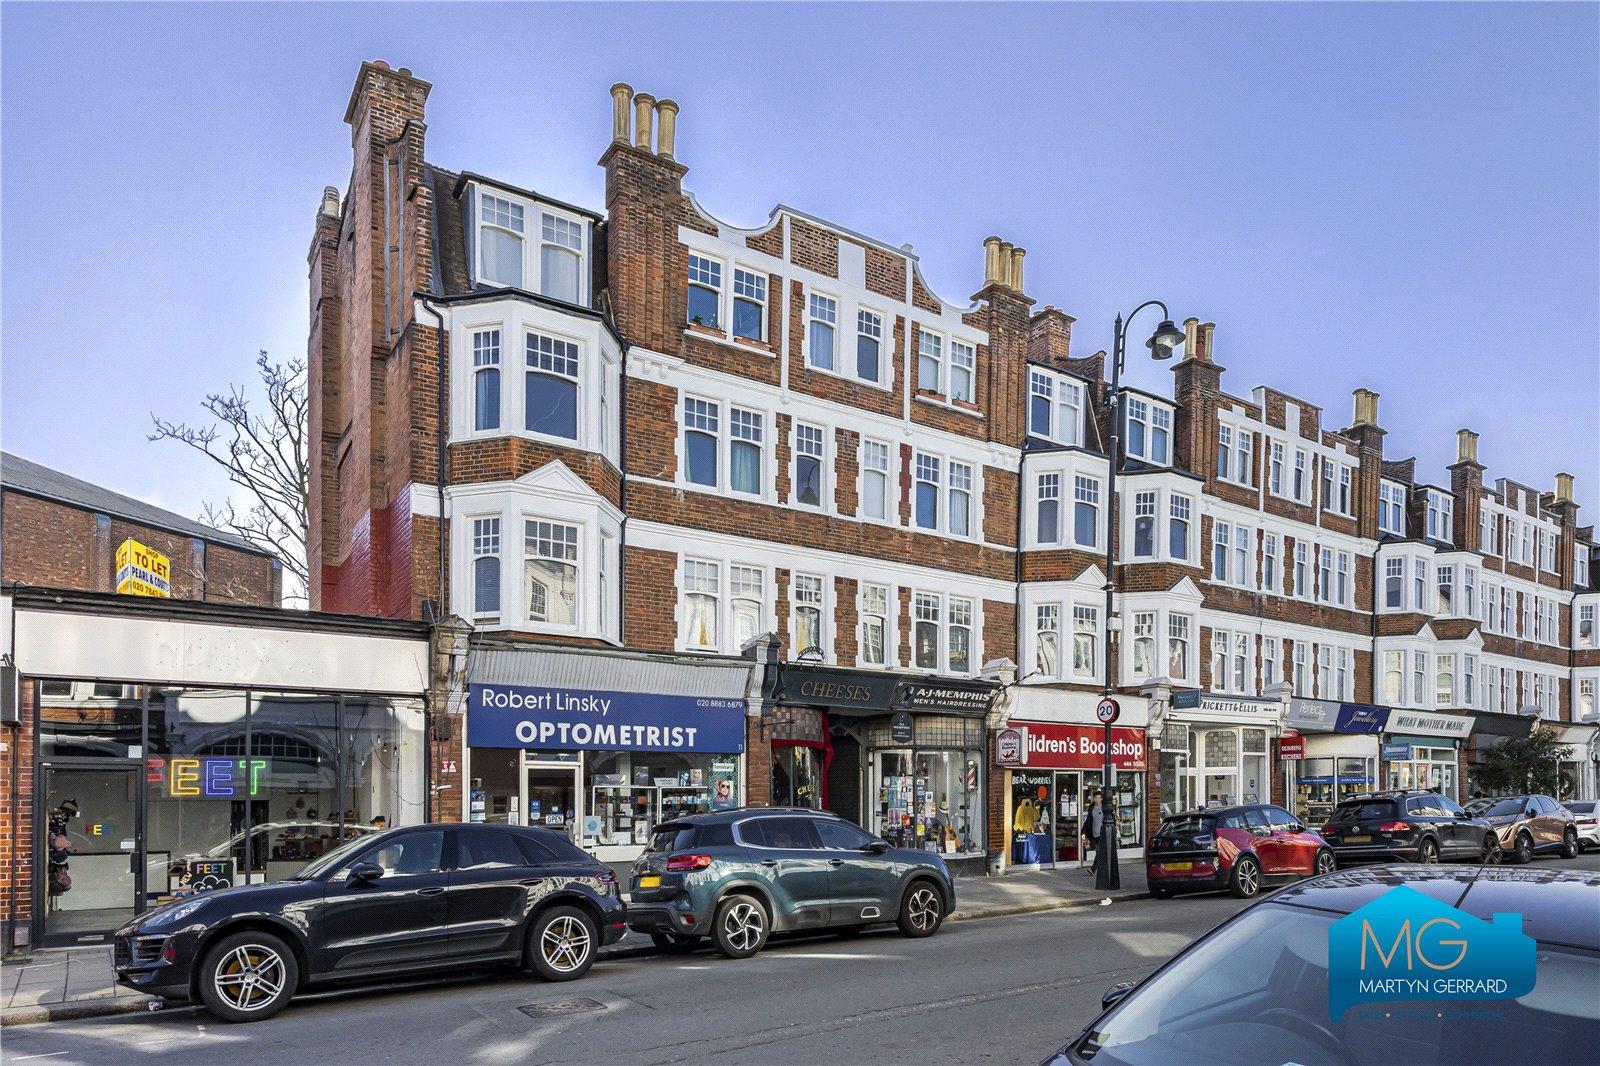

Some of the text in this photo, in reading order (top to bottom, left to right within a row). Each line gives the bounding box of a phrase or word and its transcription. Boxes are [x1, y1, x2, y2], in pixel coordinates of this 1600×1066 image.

[146, 548, 159, 559] SHOP
[135, 551, 167, 578] TO LET
[131, 566, 149, 582] PEARL
[132, 581, 144, 592] 020
[800, 681, 872, 701] CHEESES
[482, 688, 611, 716] Robert Linsky
[696, 699, 709, 707] 020
[710, 699, 726, 708] 8883
[937, 700, 987, 708] HAIRDRESSING
[1299, 702, 1323, 715] Perfect
[1099, 705, 1112, 716] 20
[1396, 715, 1465, 731] WHAT MOTHER MADE
[515, 720, 697, 747] OPTOMETRIST
[737, 743, 743, 751] 11
[1080, 736, 1143, 760] Booshop
[547, 816, 563, 824] OPEN
[196, 863, 228, 875] FEET
[180, 871, 194, 886] NEW
